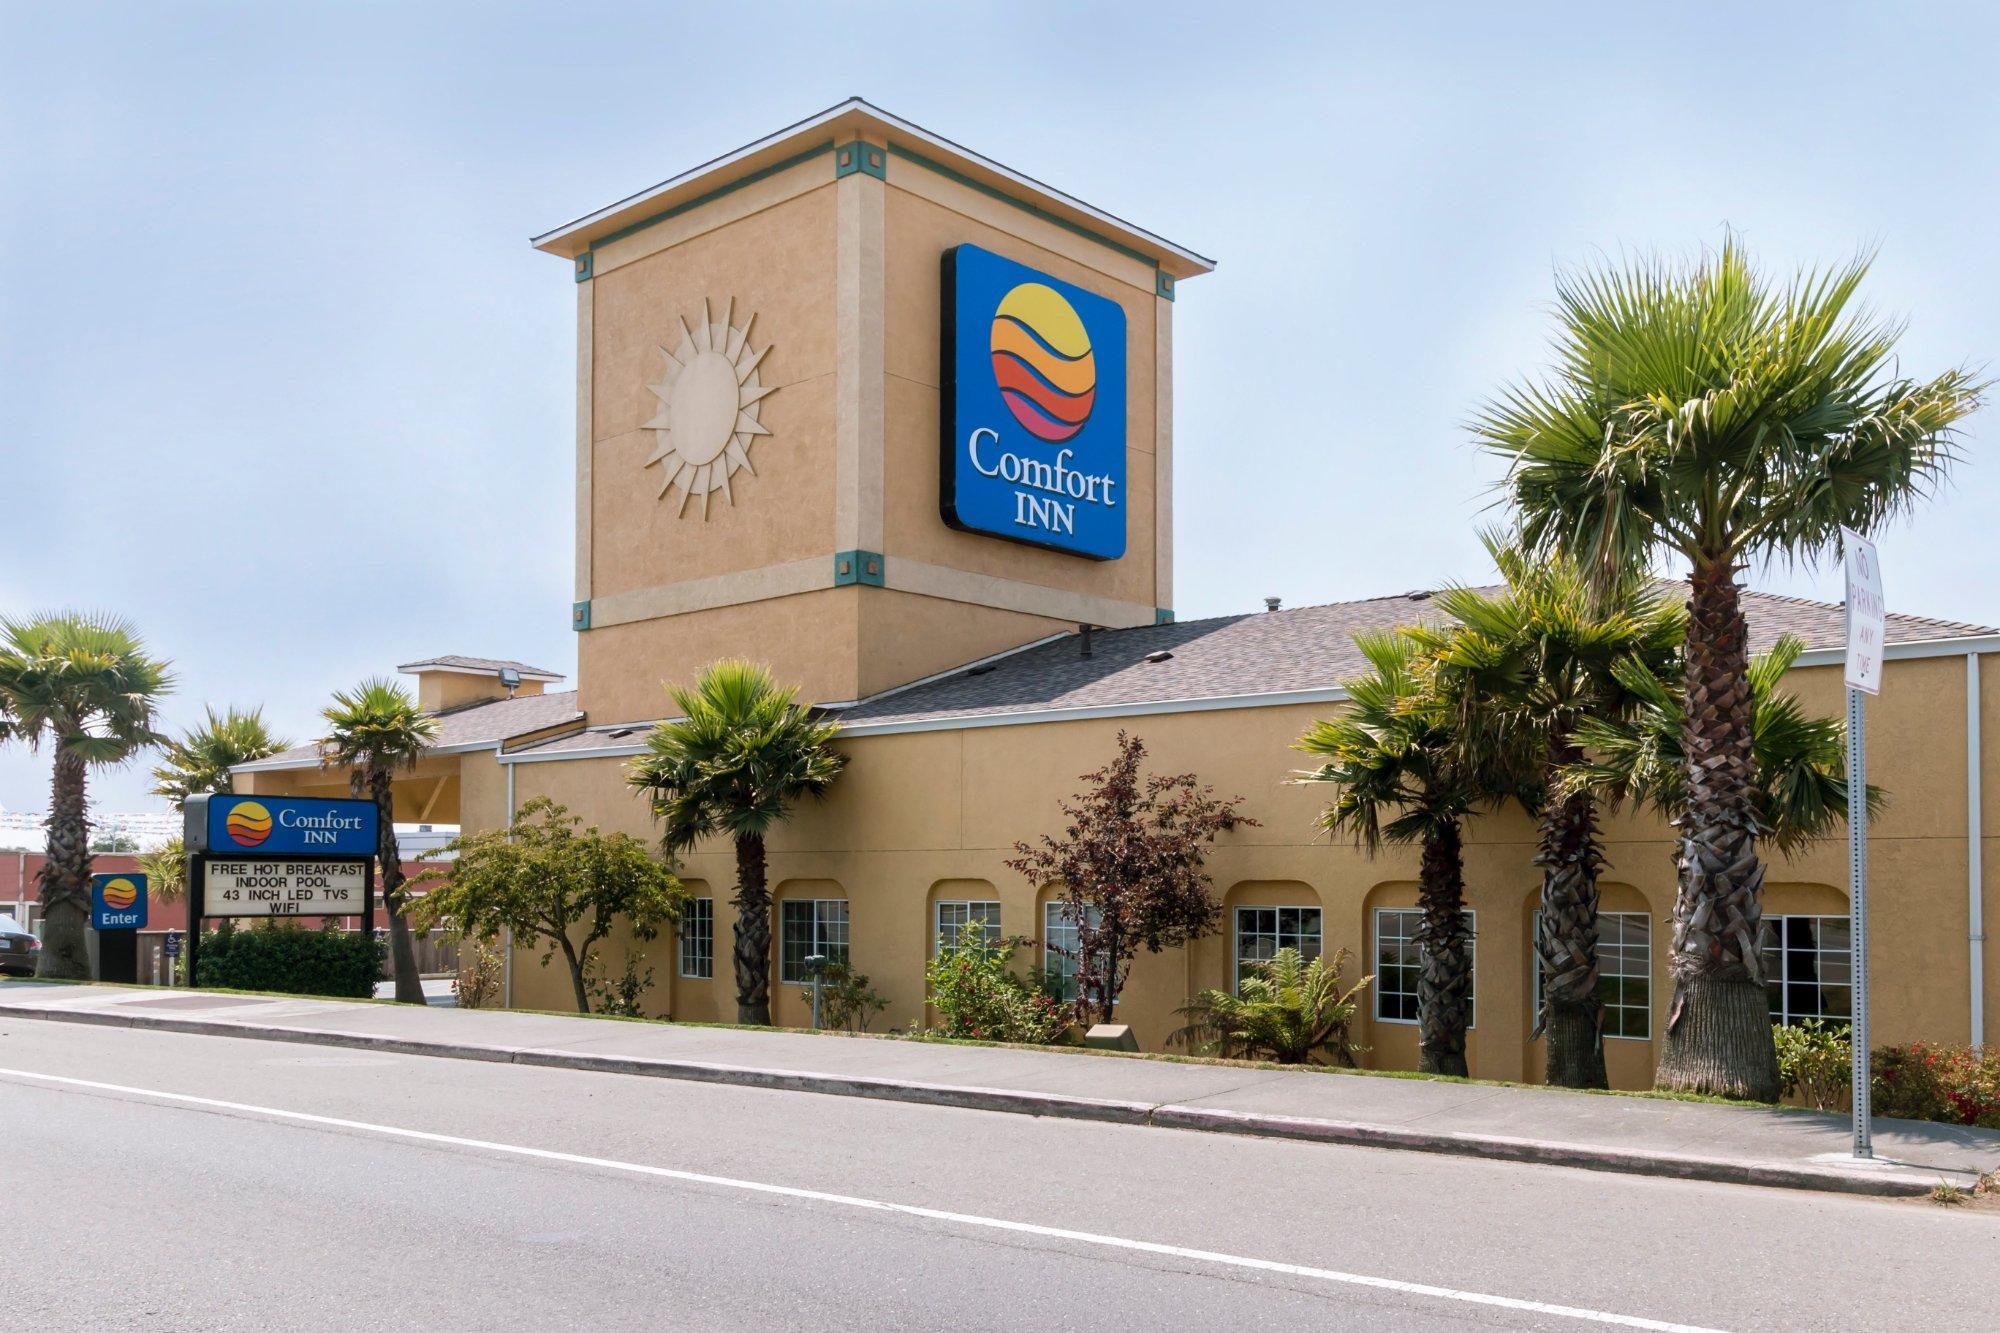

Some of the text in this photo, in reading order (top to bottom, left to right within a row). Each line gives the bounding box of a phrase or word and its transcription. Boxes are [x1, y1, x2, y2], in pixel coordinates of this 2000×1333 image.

[968, 427, 1116, 506] Comfort
[1014, 490, 1075, 535] INN
[1854, 550, 1869, 580] NO
[1851, 582, 1882, 623] PARKING
[1859, 626, 1874, 646] ANY
[1857, 652, 1871, 673] TIME
[278, 808, 363, 830] Comfort
[303, 830, 338, 844] INN
[211, 864, 364, 875] FREE HOT BREAKFAST
[236, 877, 331, 888] INDOOR POOL
[222, 890, 349, 900] 43 INCH LED TVS
[270, 902, 299, 913] WIFI
[102, 913, 138, 925] Enter
